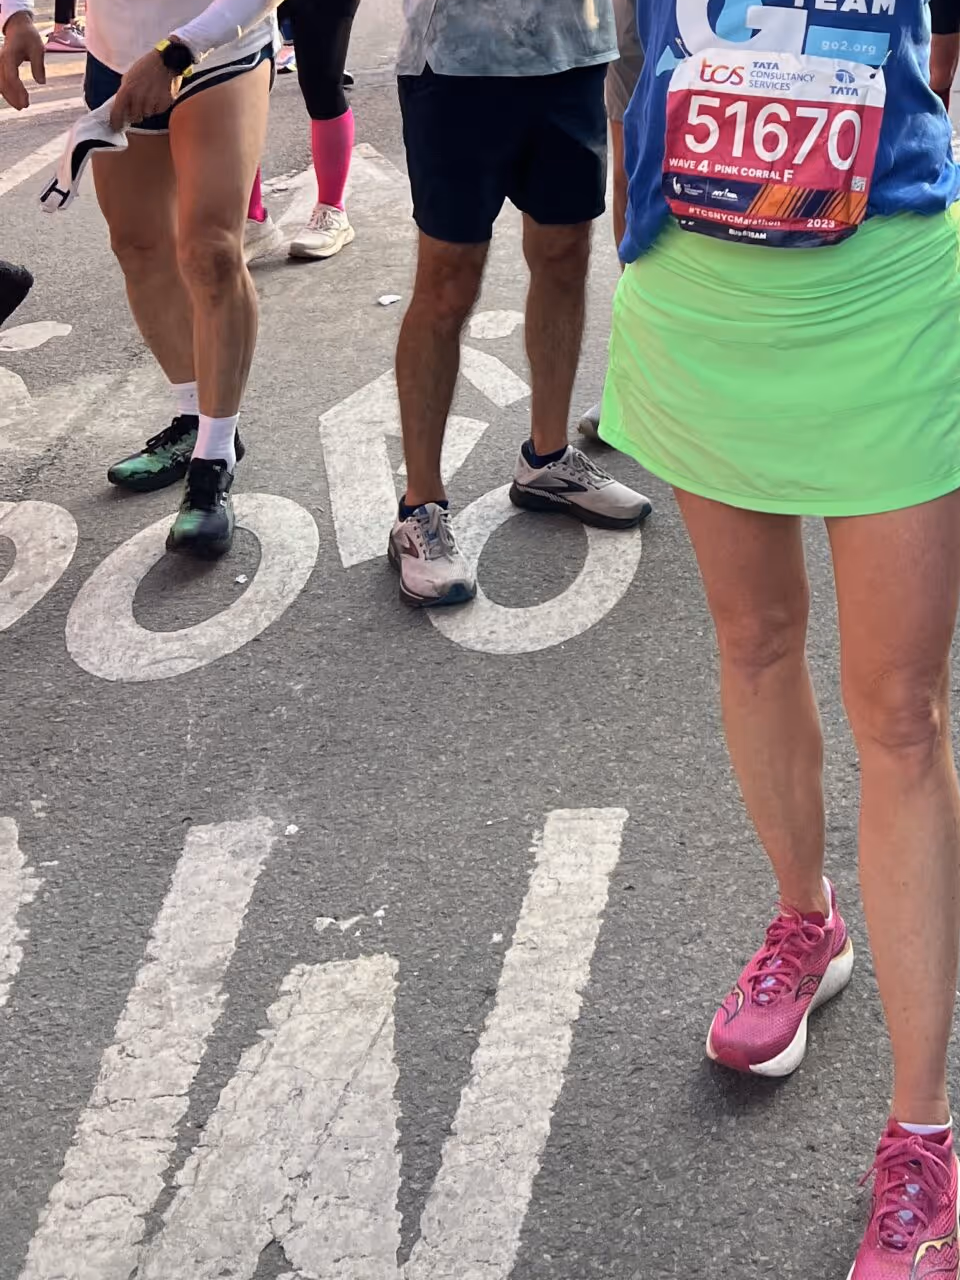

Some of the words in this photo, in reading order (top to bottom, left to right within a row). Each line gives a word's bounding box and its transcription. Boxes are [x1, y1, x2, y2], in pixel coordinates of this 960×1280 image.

[820, 39, 877, 55] go2.org
[699, 57, 745, 86] tcs
[752, 61, 780, 71] TATA
[829, 86, 859, 97] TATA
[749, 79, 791, 91] SERVICES
[750, 70, 816, 83] CONSULTANCY
[684, 94, 862, 170] 51670
[668, 158, 696, 169] WAVE
[697, 159, 709, 174] 4
[714, 164, 740, 175] PINK
[739, 166, 782, 181] CORRAL
[783, 169, 794, 183] F
[688, 207, 781, 227] #TCSNYCMarathon
[806, 218, 836, 228] 2023
